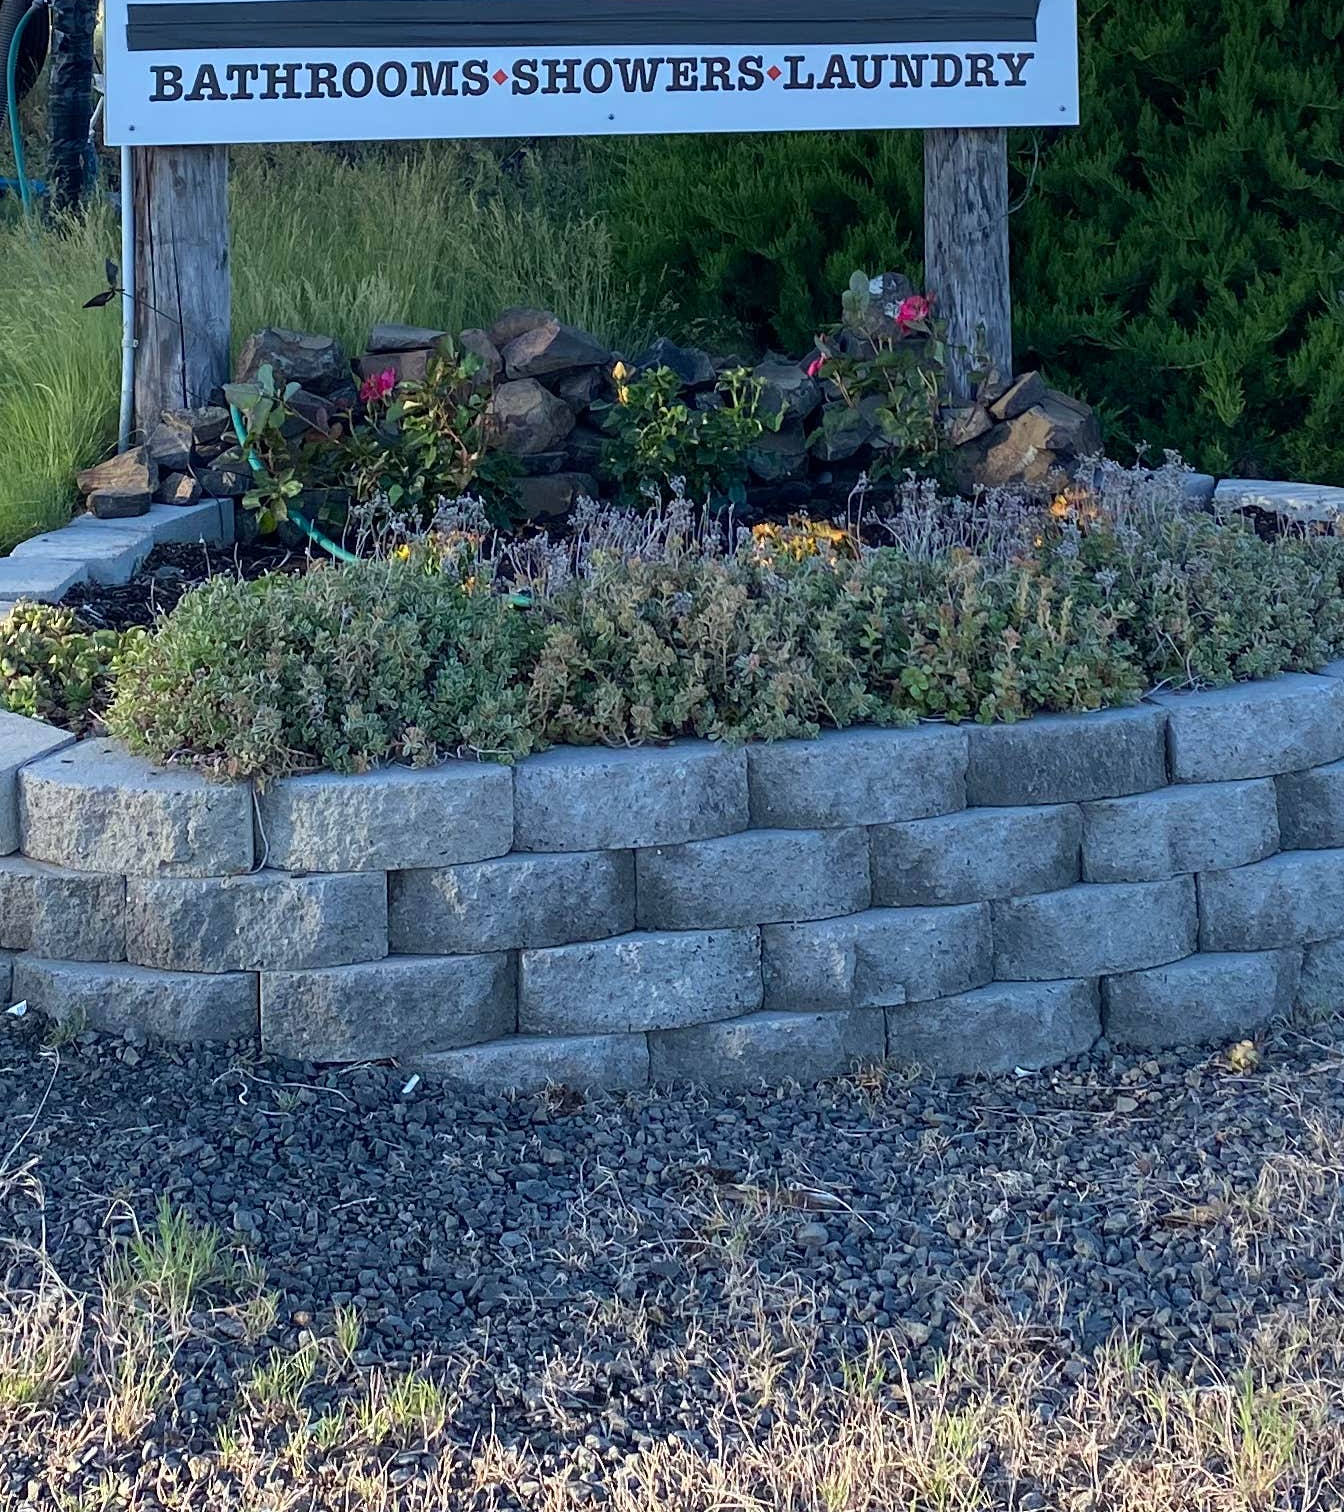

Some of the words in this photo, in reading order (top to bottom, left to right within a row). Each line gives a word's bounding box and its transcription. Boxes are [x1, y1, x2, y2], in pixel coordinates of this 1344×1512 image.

[149, 60, 489, 102] BATHROOMS
[512, 56, 761, 95] SHOWERS
[783, 53, 1034, 89] LAUNDRY
